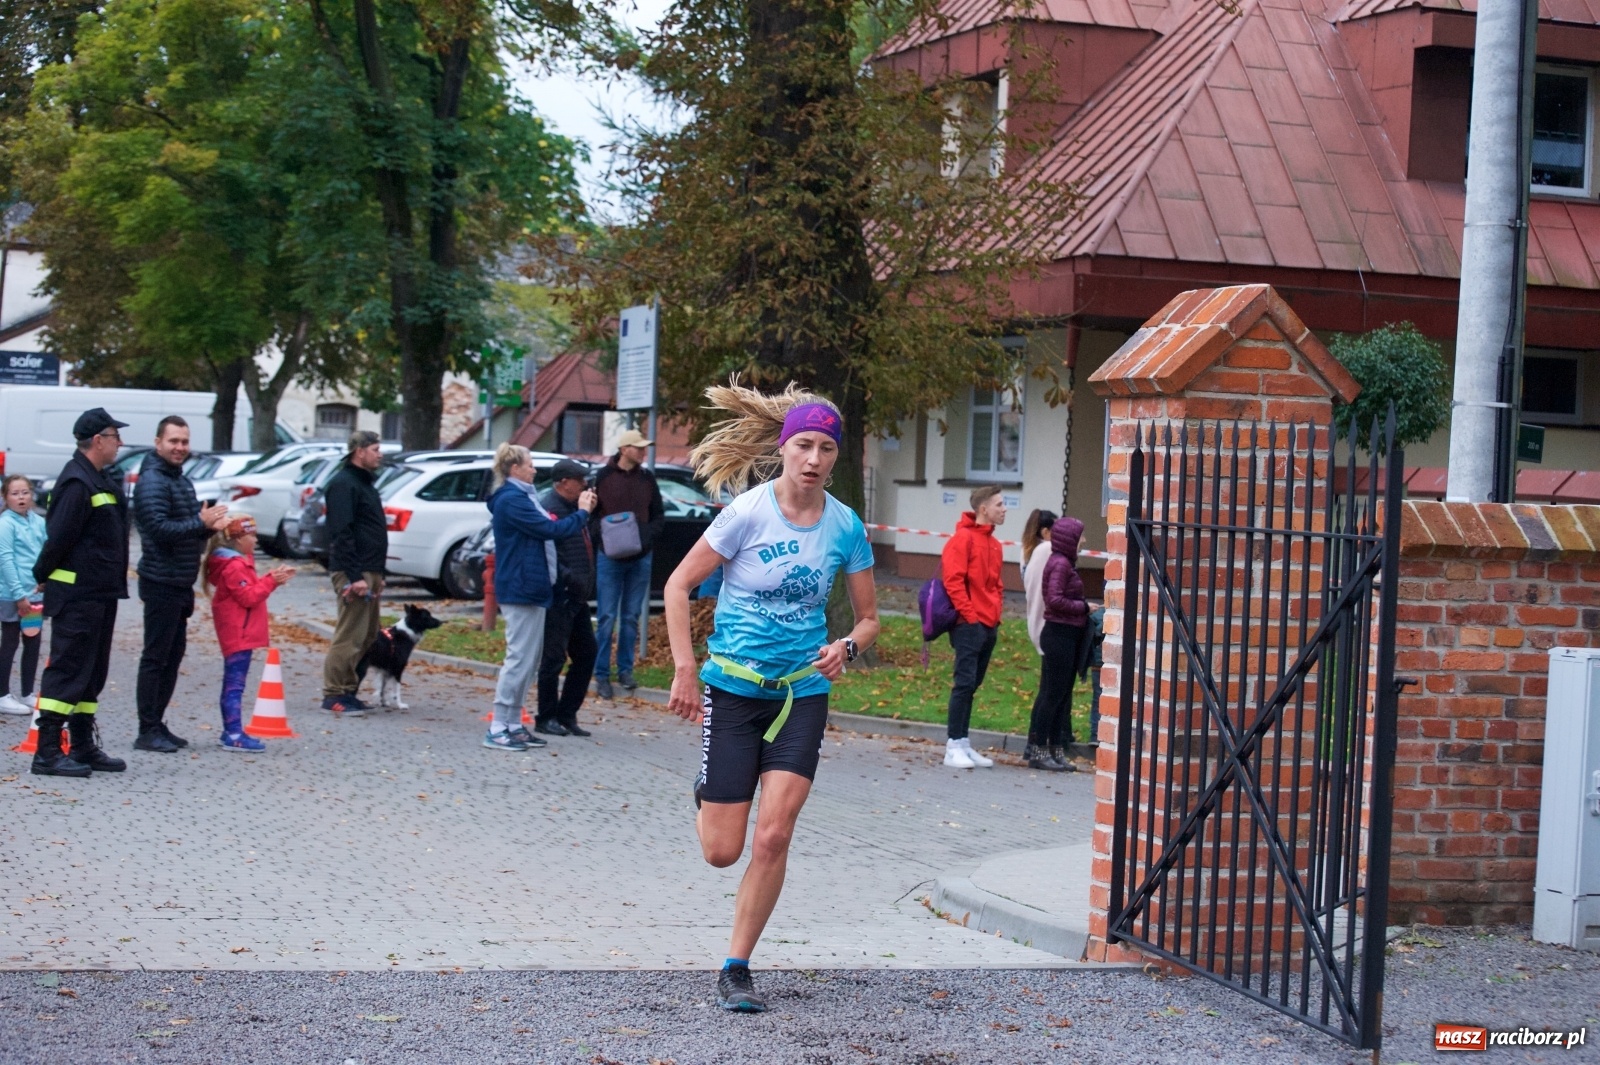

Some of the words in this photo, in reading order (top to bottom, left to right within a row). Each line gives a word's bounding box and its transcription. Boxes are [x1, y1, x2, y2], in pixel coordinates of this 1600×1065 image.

[10, 354, 43, 368] safer
[758, 540, 799, 564] BIEG
[800, 568, 823, 588] km
